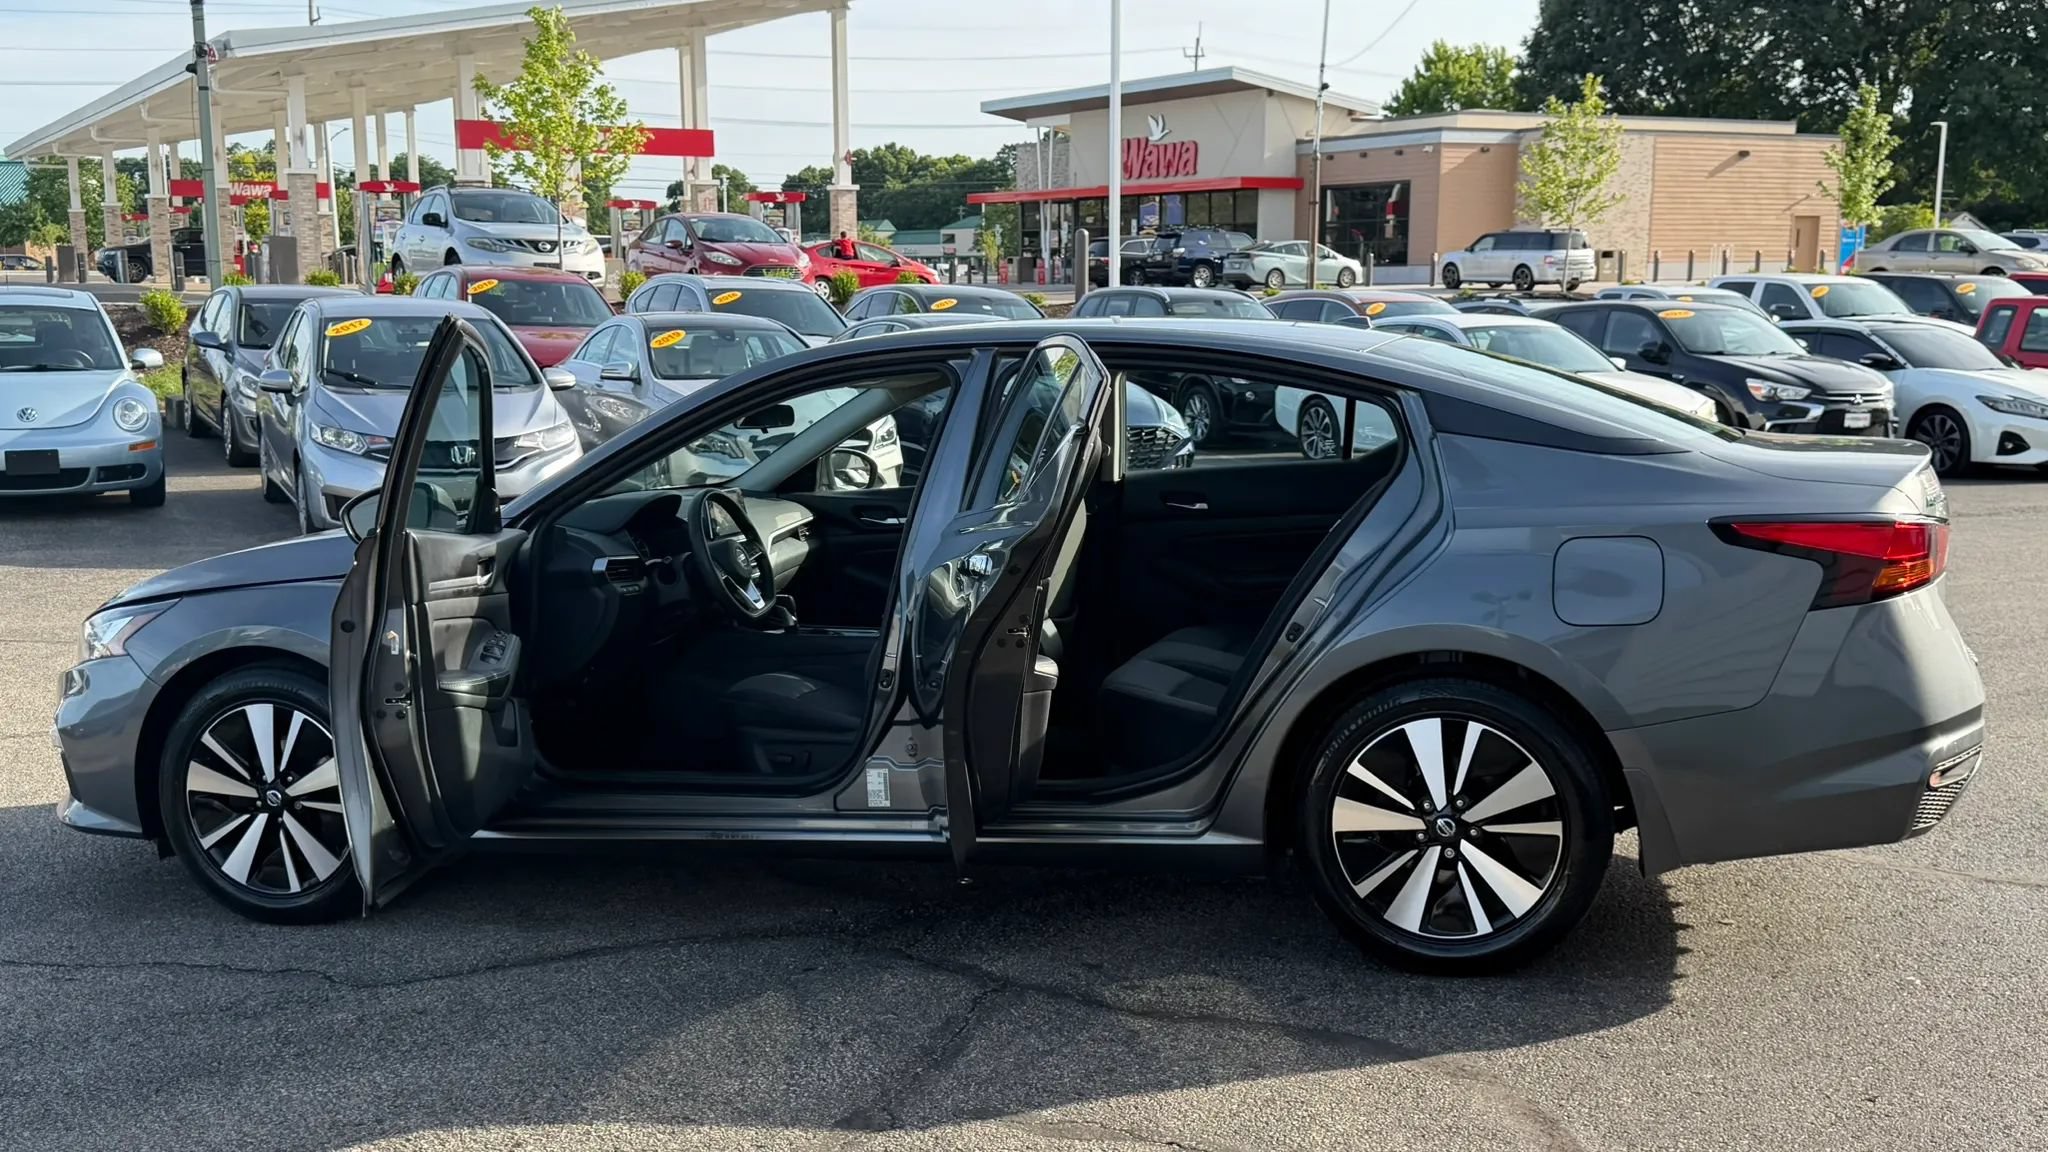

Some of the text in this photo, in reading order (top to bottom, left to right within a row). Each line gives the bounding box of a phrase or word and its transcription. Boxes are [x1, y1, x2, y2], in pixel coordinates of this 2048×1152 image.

[1121, 137, 1198, 180] Wawa
[332, 320, 363, 334] 2017
[654, 331, 681, 346] 2019
